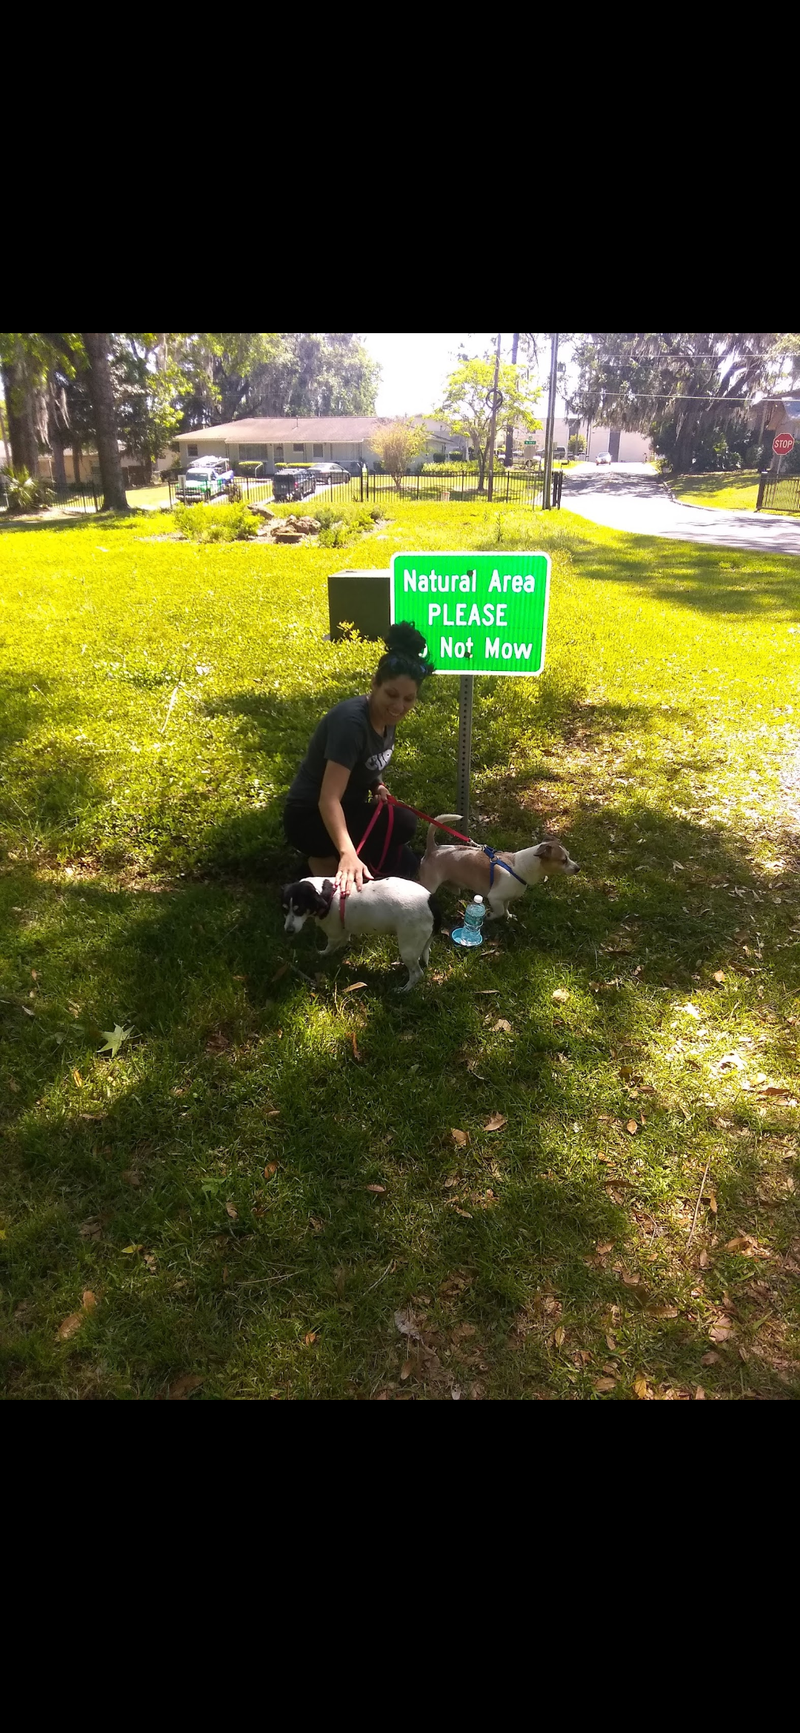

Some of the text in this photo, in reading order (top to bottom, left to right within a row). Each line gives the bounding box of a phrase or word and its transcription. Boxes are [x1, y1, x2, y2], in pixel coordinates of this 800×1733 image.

[774, 439, 793, 448] STOP
[403, 569, 536, 593] Natural Area
[428, 603, 508, 626] PLEASE
[440, 636, 474, 658] Not
[485, 637, 533, 660] Mow
